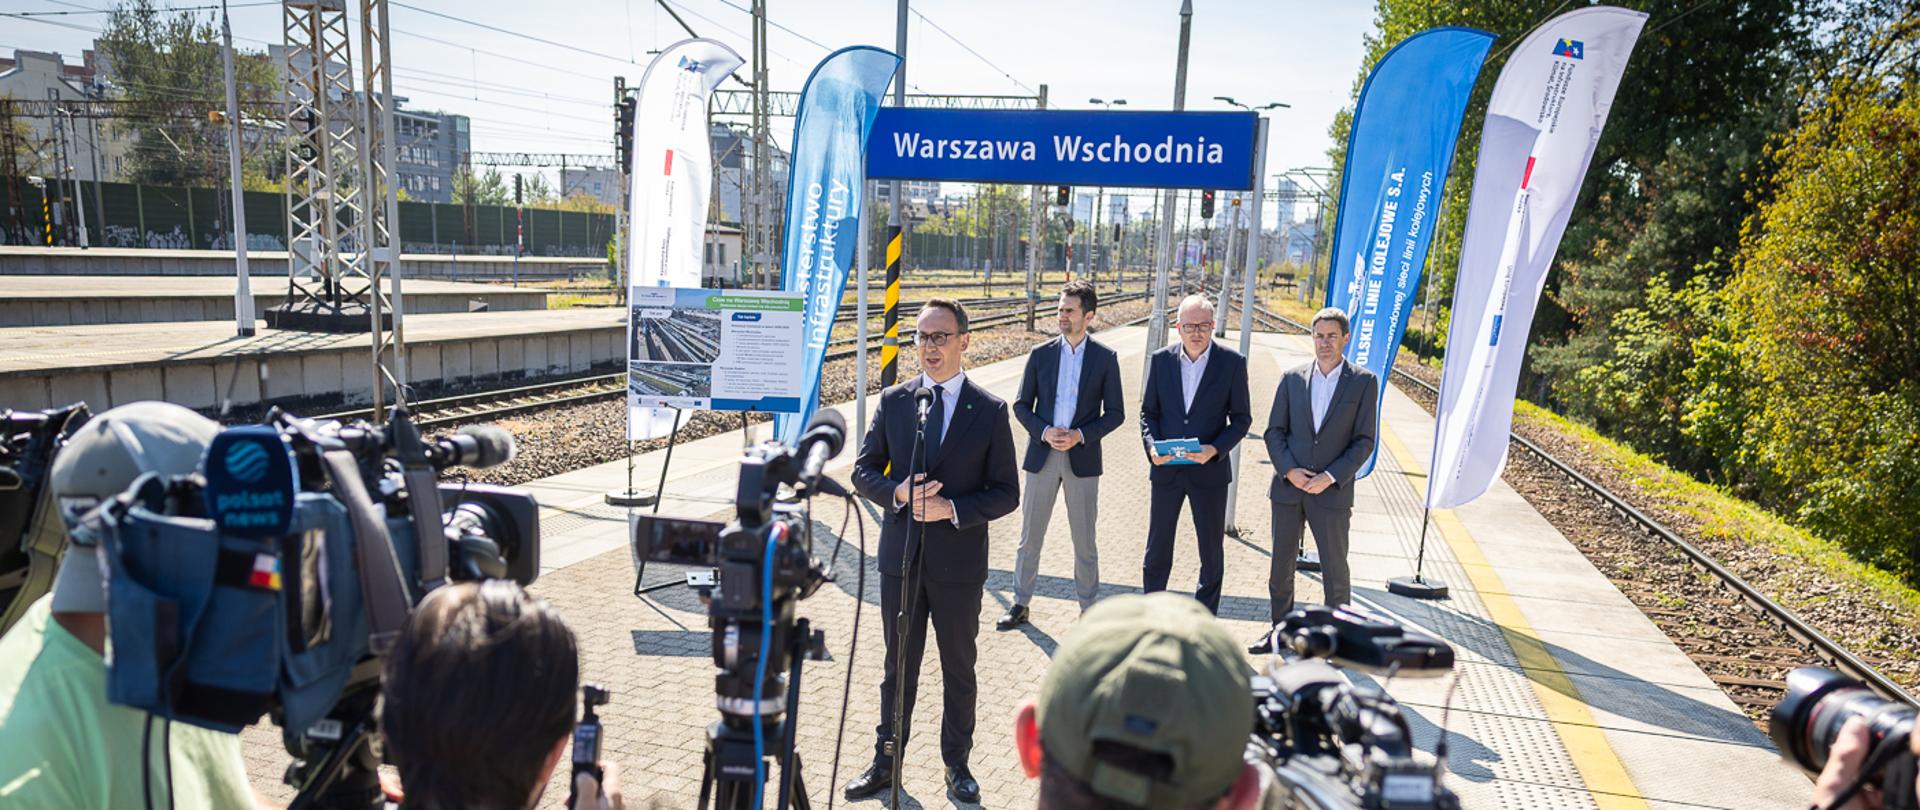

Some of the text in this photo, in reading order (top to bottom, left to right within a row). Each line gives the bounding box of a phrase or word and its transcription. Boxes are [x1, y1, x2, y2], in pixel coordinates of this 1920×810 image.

[1549, 63, 1576, 134] Fundusze Europejskie
[893, 132, 1223, 164] Warszawa Wschodnia
[1408, 171, 1433, 238] kolejowych
[808, 178, 850, 350] Infrastruktury
[1402, 239, 1416, 260] linii
[1356, 167, 1406, 366] OLSKIE LINIE KOLEJOWE S.A.
[1397, 261, 1410, 289] sieci
[217, 490, 283, 513] polsat
[224, 511, 279, 527] news
